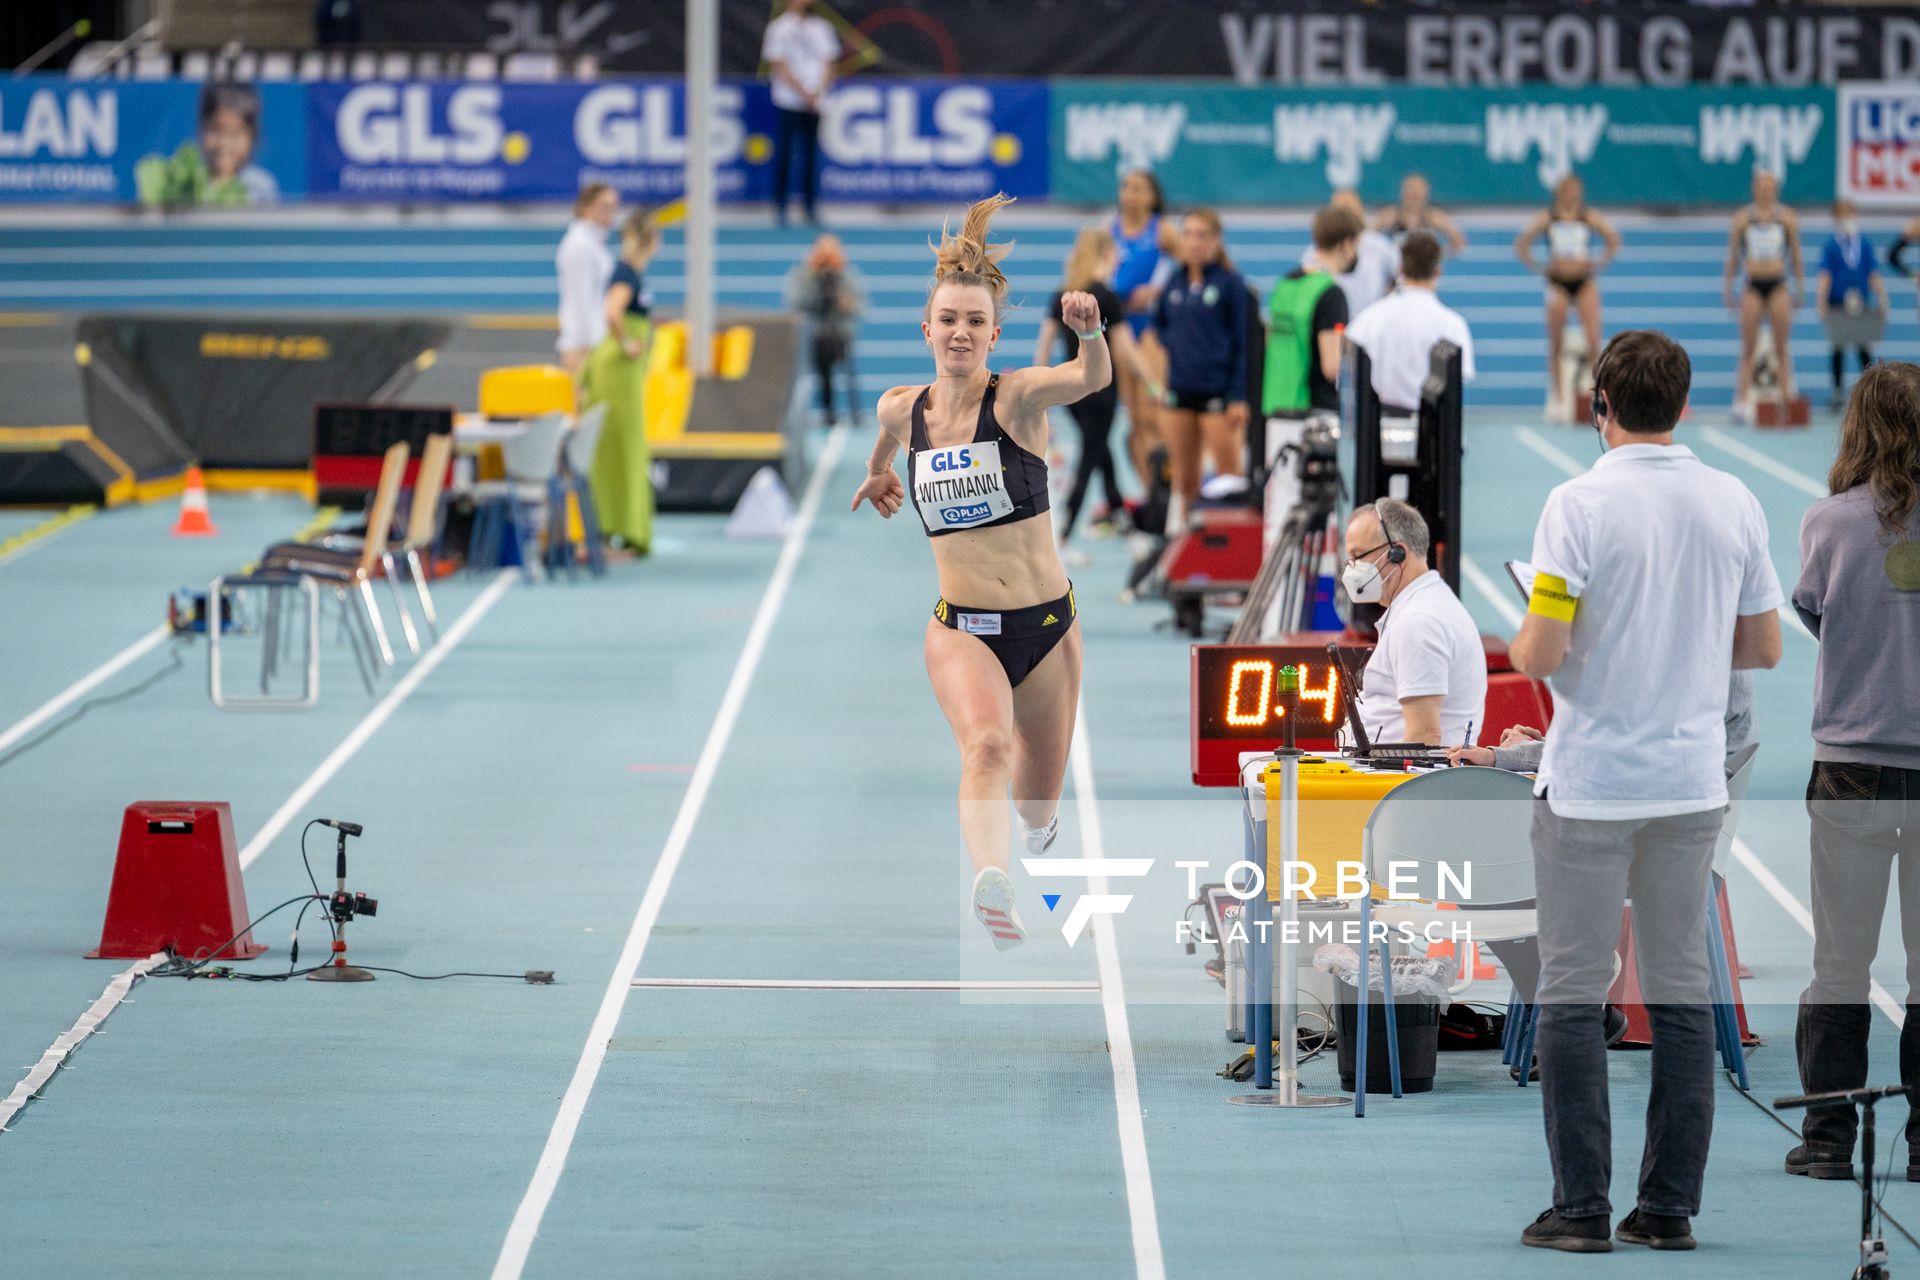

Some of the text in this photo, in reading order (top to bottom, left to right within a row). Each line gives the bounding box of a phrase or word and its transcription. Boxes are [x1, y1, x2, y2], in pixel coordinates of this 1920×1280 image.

[1219, 14, 1384, 88] VIEL
[1406, 14, 1694, 88] ERFOLG
[1712, 16, 1862, 87] AUF
[919, 473, 999, 503] WITTMANN
[960, 506, 989, 517] PLAN
[1228, 661, 1338, 725] 0.4
